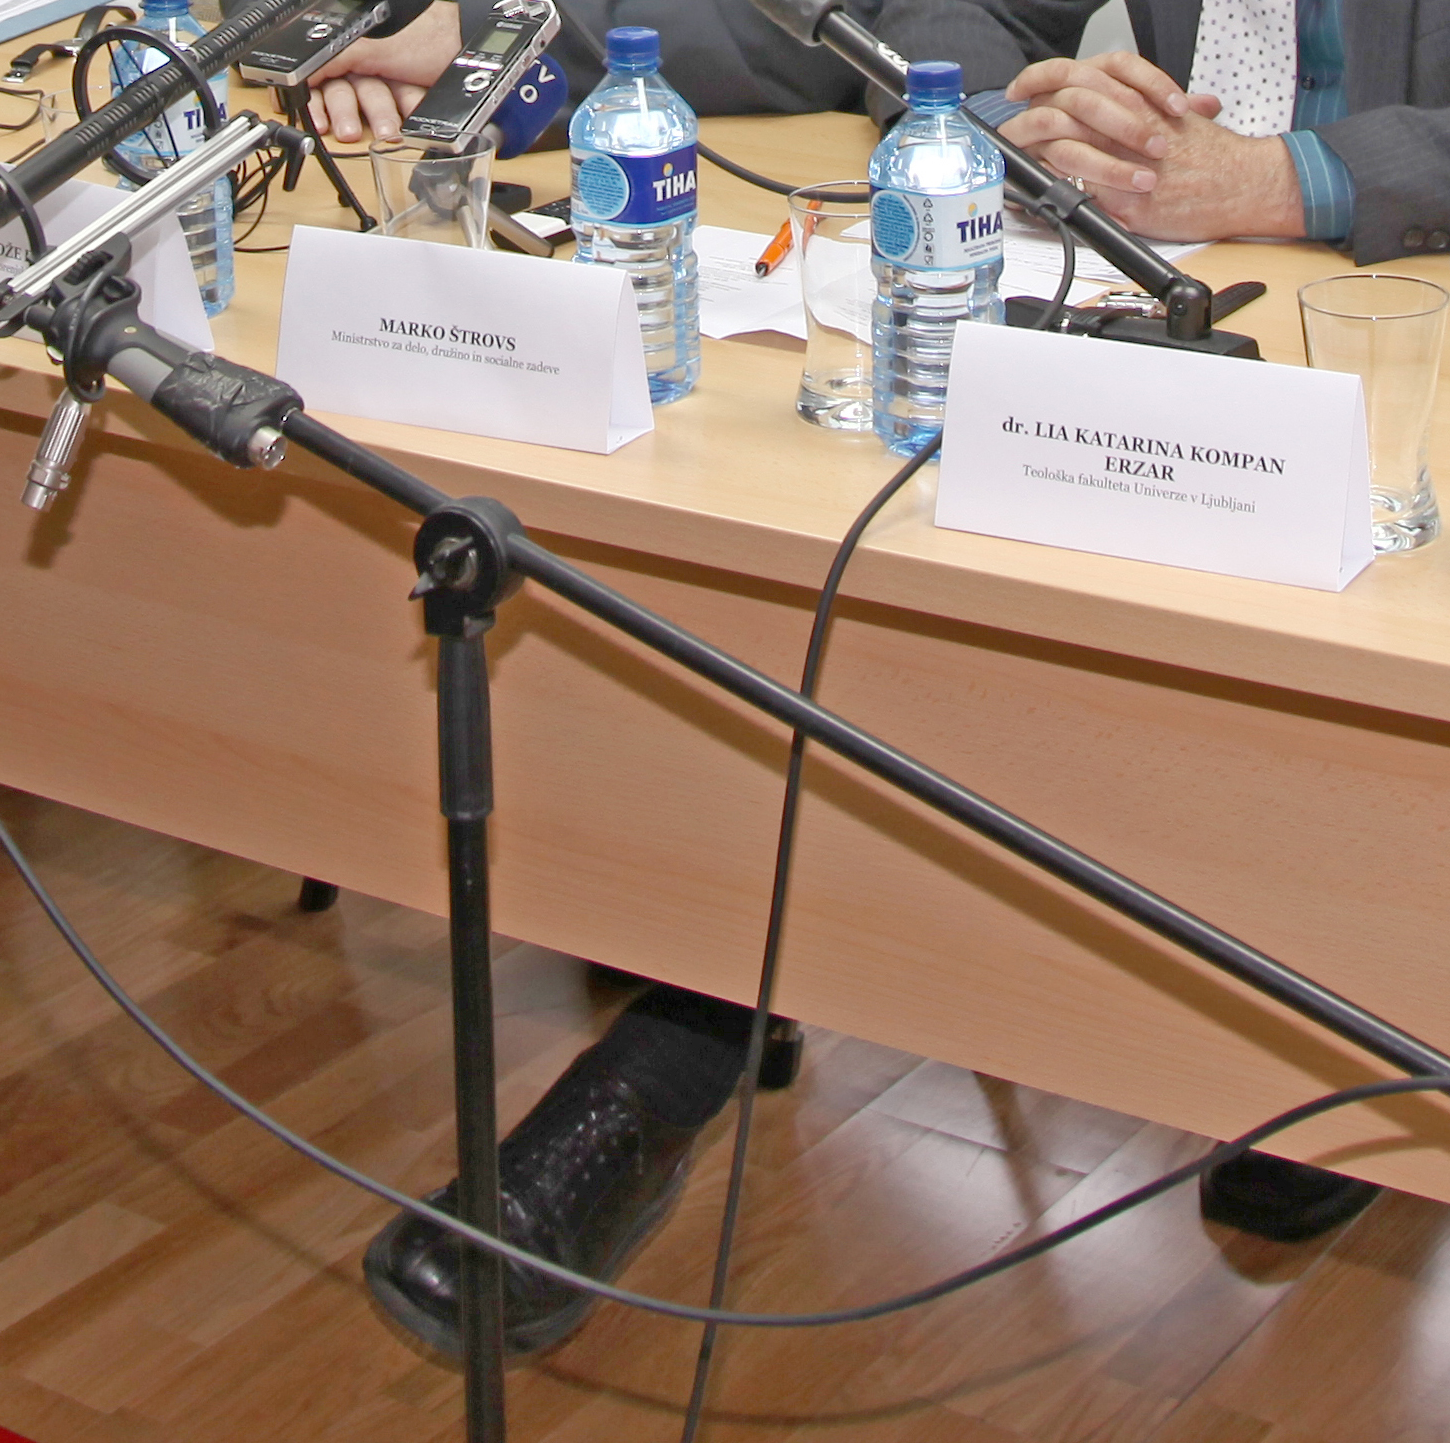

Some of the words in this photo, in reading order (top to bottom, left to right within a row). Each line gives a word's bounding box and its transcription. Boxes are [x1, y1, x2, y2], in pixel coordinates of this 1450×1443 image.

[183, 102, 227, 130] TIA
[652, 170, 697, 202] TIHA
[956, 211, 1003, 243] TIHA
[379, 318, 445, 341] MARKO
[449, 325, 516, 352] ŠTROVS
[332, 330, 390, 349] Ministrstvo
[391, 341, 402, 351] za
[405, 341, 429, 356] delo,
[431, 345, 470, 361] družino
[472, 350, 482, 363] in
[484, 355, 525, 370] socialne
[526, 361, 560, 376] zadeve
[1002, 416, 1029, 435] dr.
[1035, 421, 1069, 442] LIA
[1075, 427, 1185, 460] KATARINA
[1190, 445, 1286, 476] KOMPAN
[1103, 455, 1176, 483] ERZAR
[1022, 464, 1075, 484] Teološka
[1077, 473, 1130, 493] fakulteta
[1134, 483, 1188, 503] Univerze
[1191, 494, 1199, 504] v
[1201, 492, 1257, 514] Ljubljani
